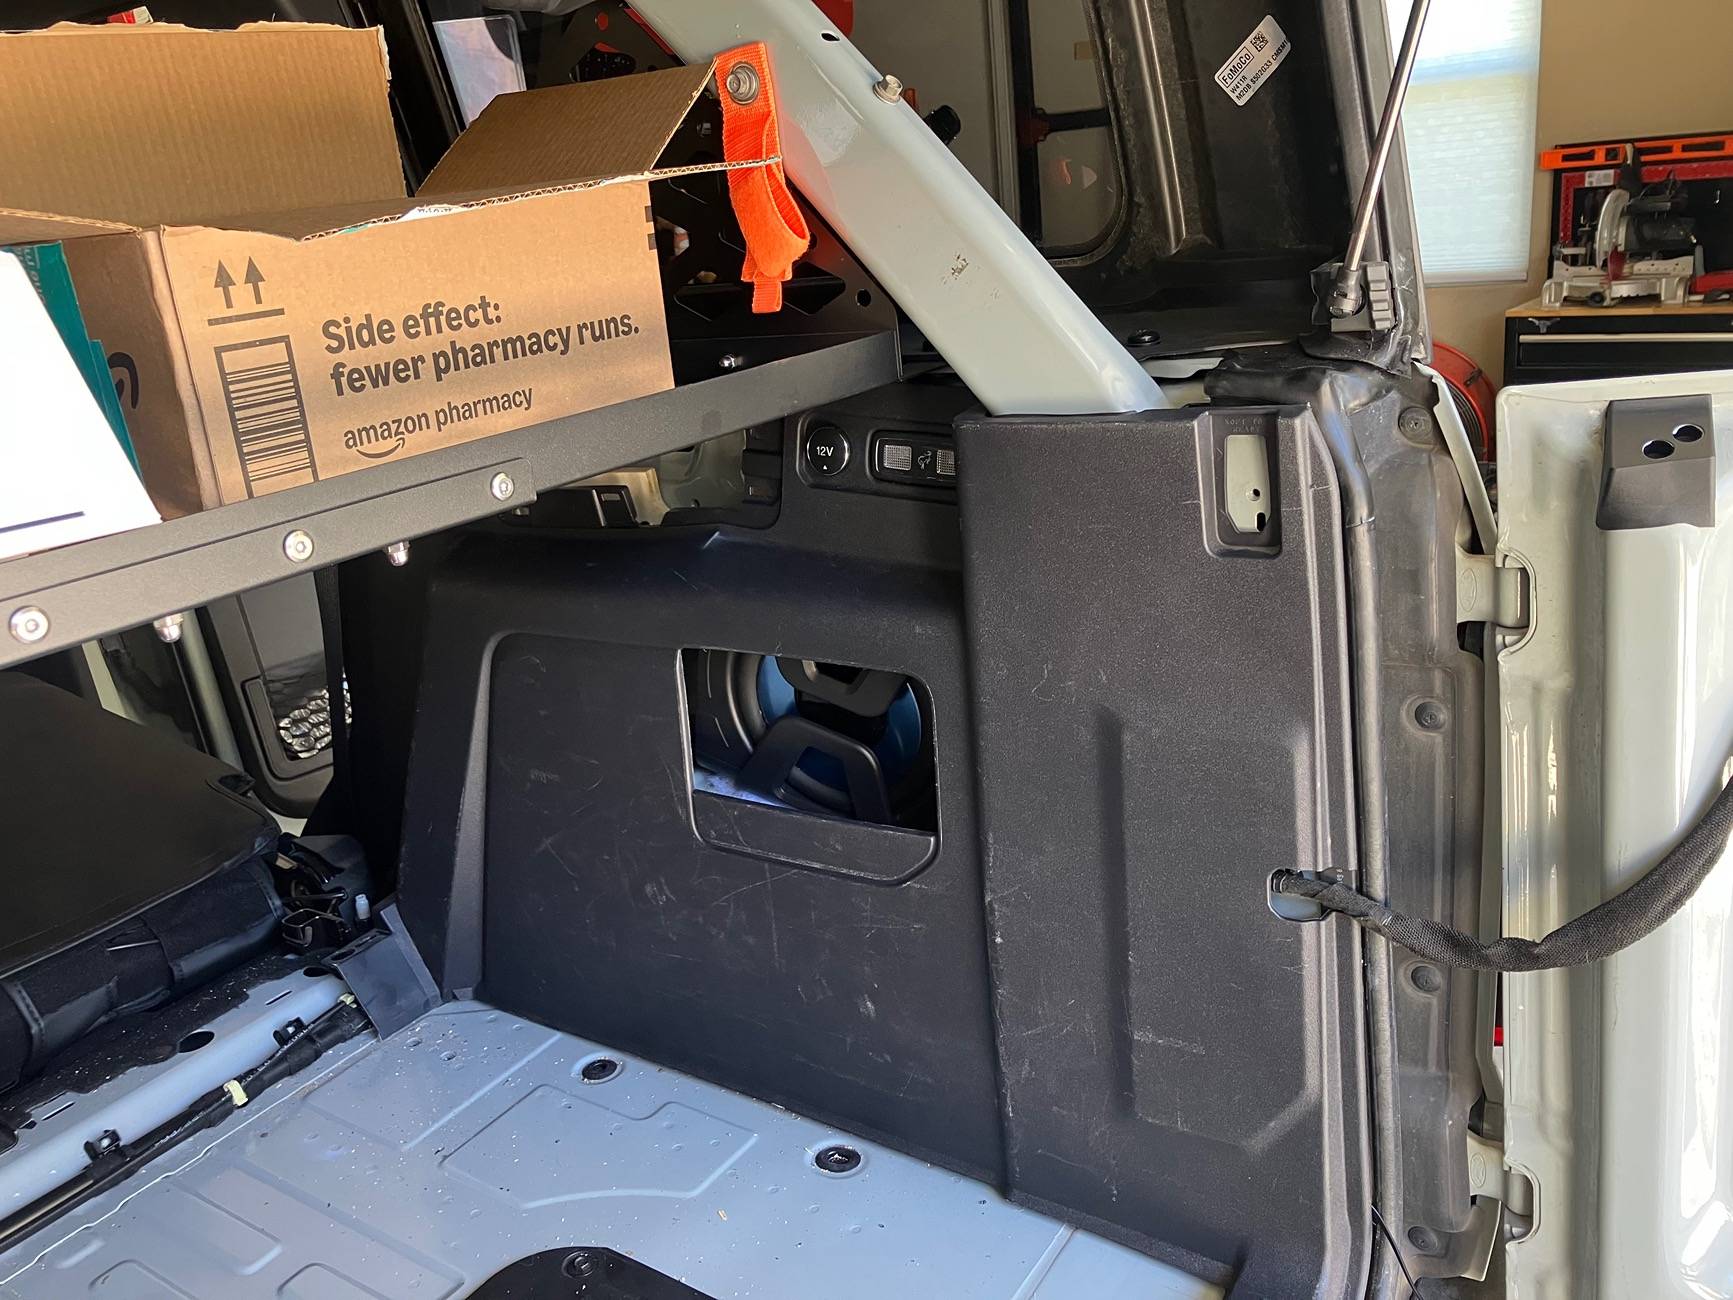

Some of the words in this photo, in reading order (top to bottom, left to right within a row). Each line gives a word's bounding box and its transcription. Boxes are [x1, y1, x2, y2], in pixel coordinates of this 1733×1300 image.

[1222, 53, 1251, 85] FoMoCo
[322, 313, 396, 354] Side
[402, 295, 502, 340] effect:
[330, 353, 426, 397] fewer
[432, 326, 571, 382] pharmacy
[576, 313, 640, 346] runs.
[343, 412, 431, 451] amazon
[434, 387, 533, 432] pharmacy
[816, 446, 834, 457] 12V
